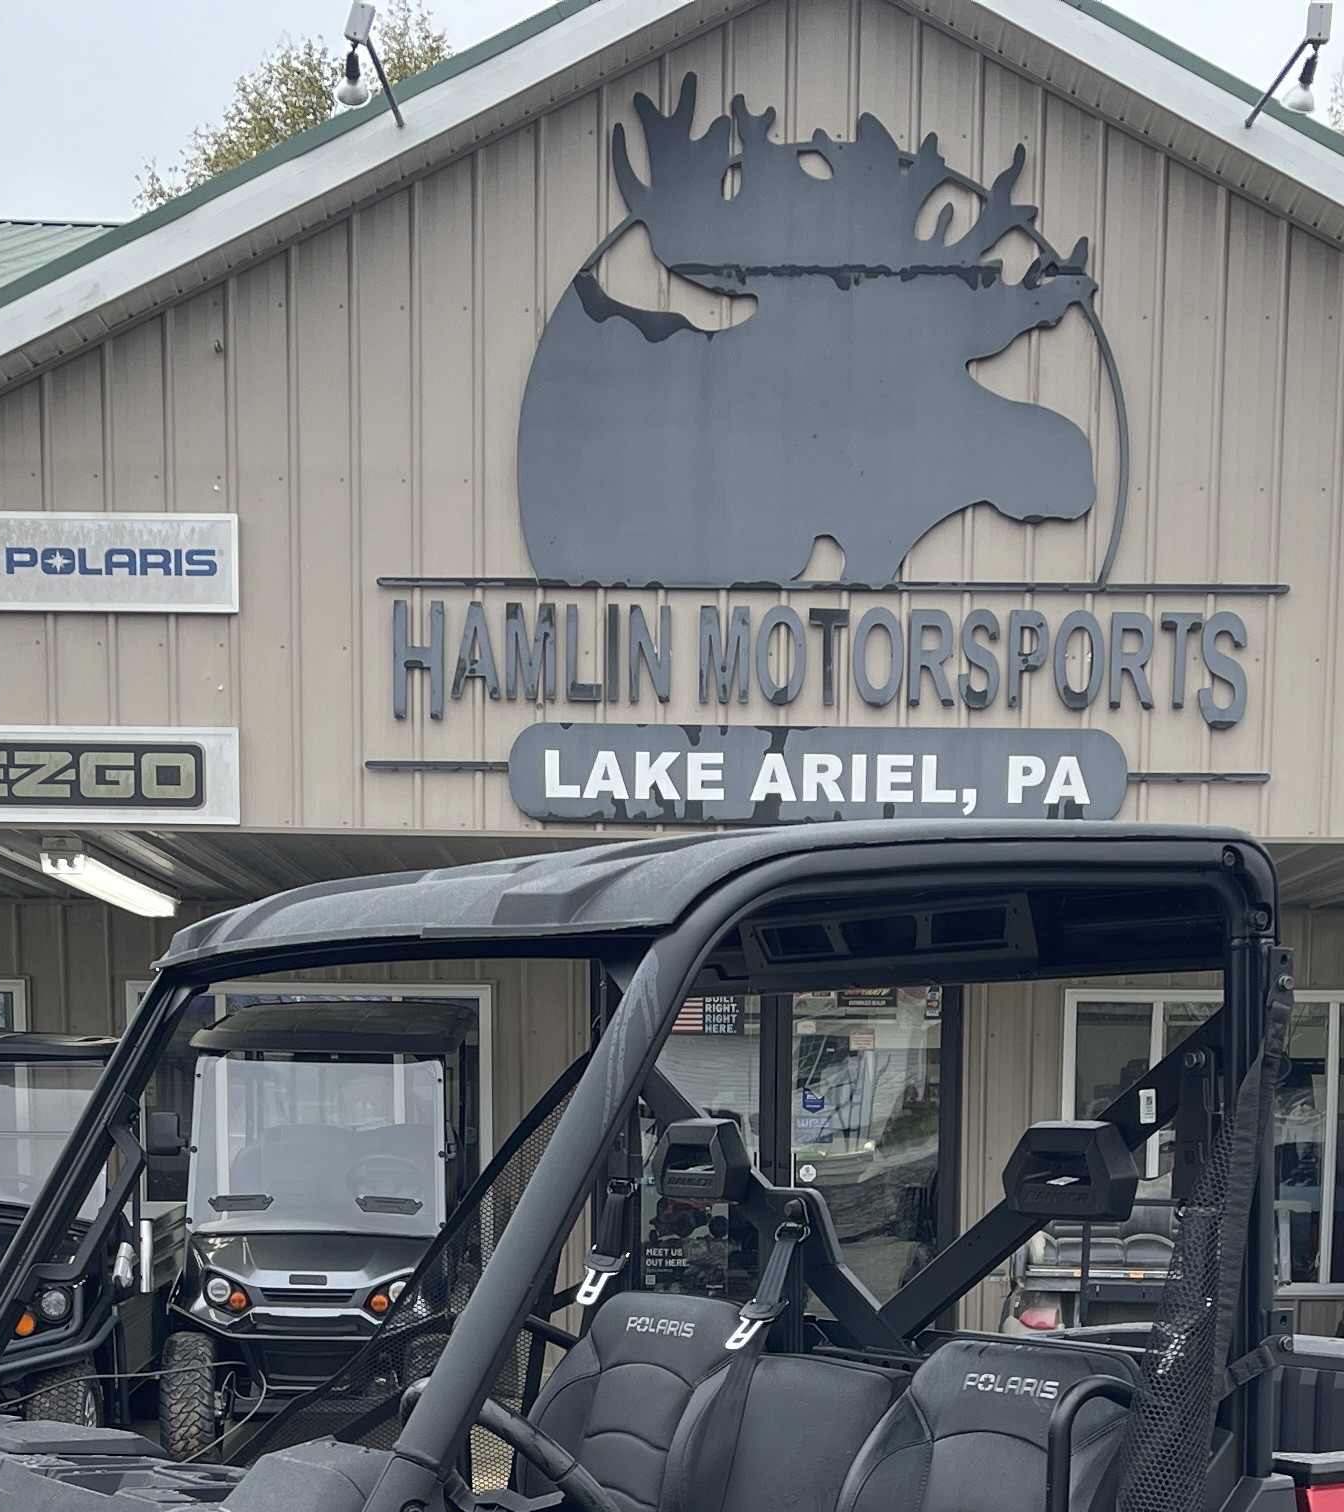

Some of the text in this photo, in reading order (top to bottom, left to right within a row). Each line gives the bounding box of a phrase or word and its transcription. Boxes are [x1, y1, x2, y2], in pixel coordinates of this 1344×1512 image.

[6, 547, 218, 577] POLARIS
[393, 600, 1248, 730] HAMLIN MOTORSPORTS
[544, 748, 1092, 816] LAKE ARIEL, PA
[704, 1003, 739, 1013] RIGHT.
[704, 1014, 737, 1023] RIGHT
[704, 1024, 737, 1033] HERE.
[645, 1248, 683, 1256] MEET US
[645, 1259, 663, 1267] OUT
[625, 1316, 696, 1339] POLARIS
[962, 1373, 1060, 1400] POLARIS
